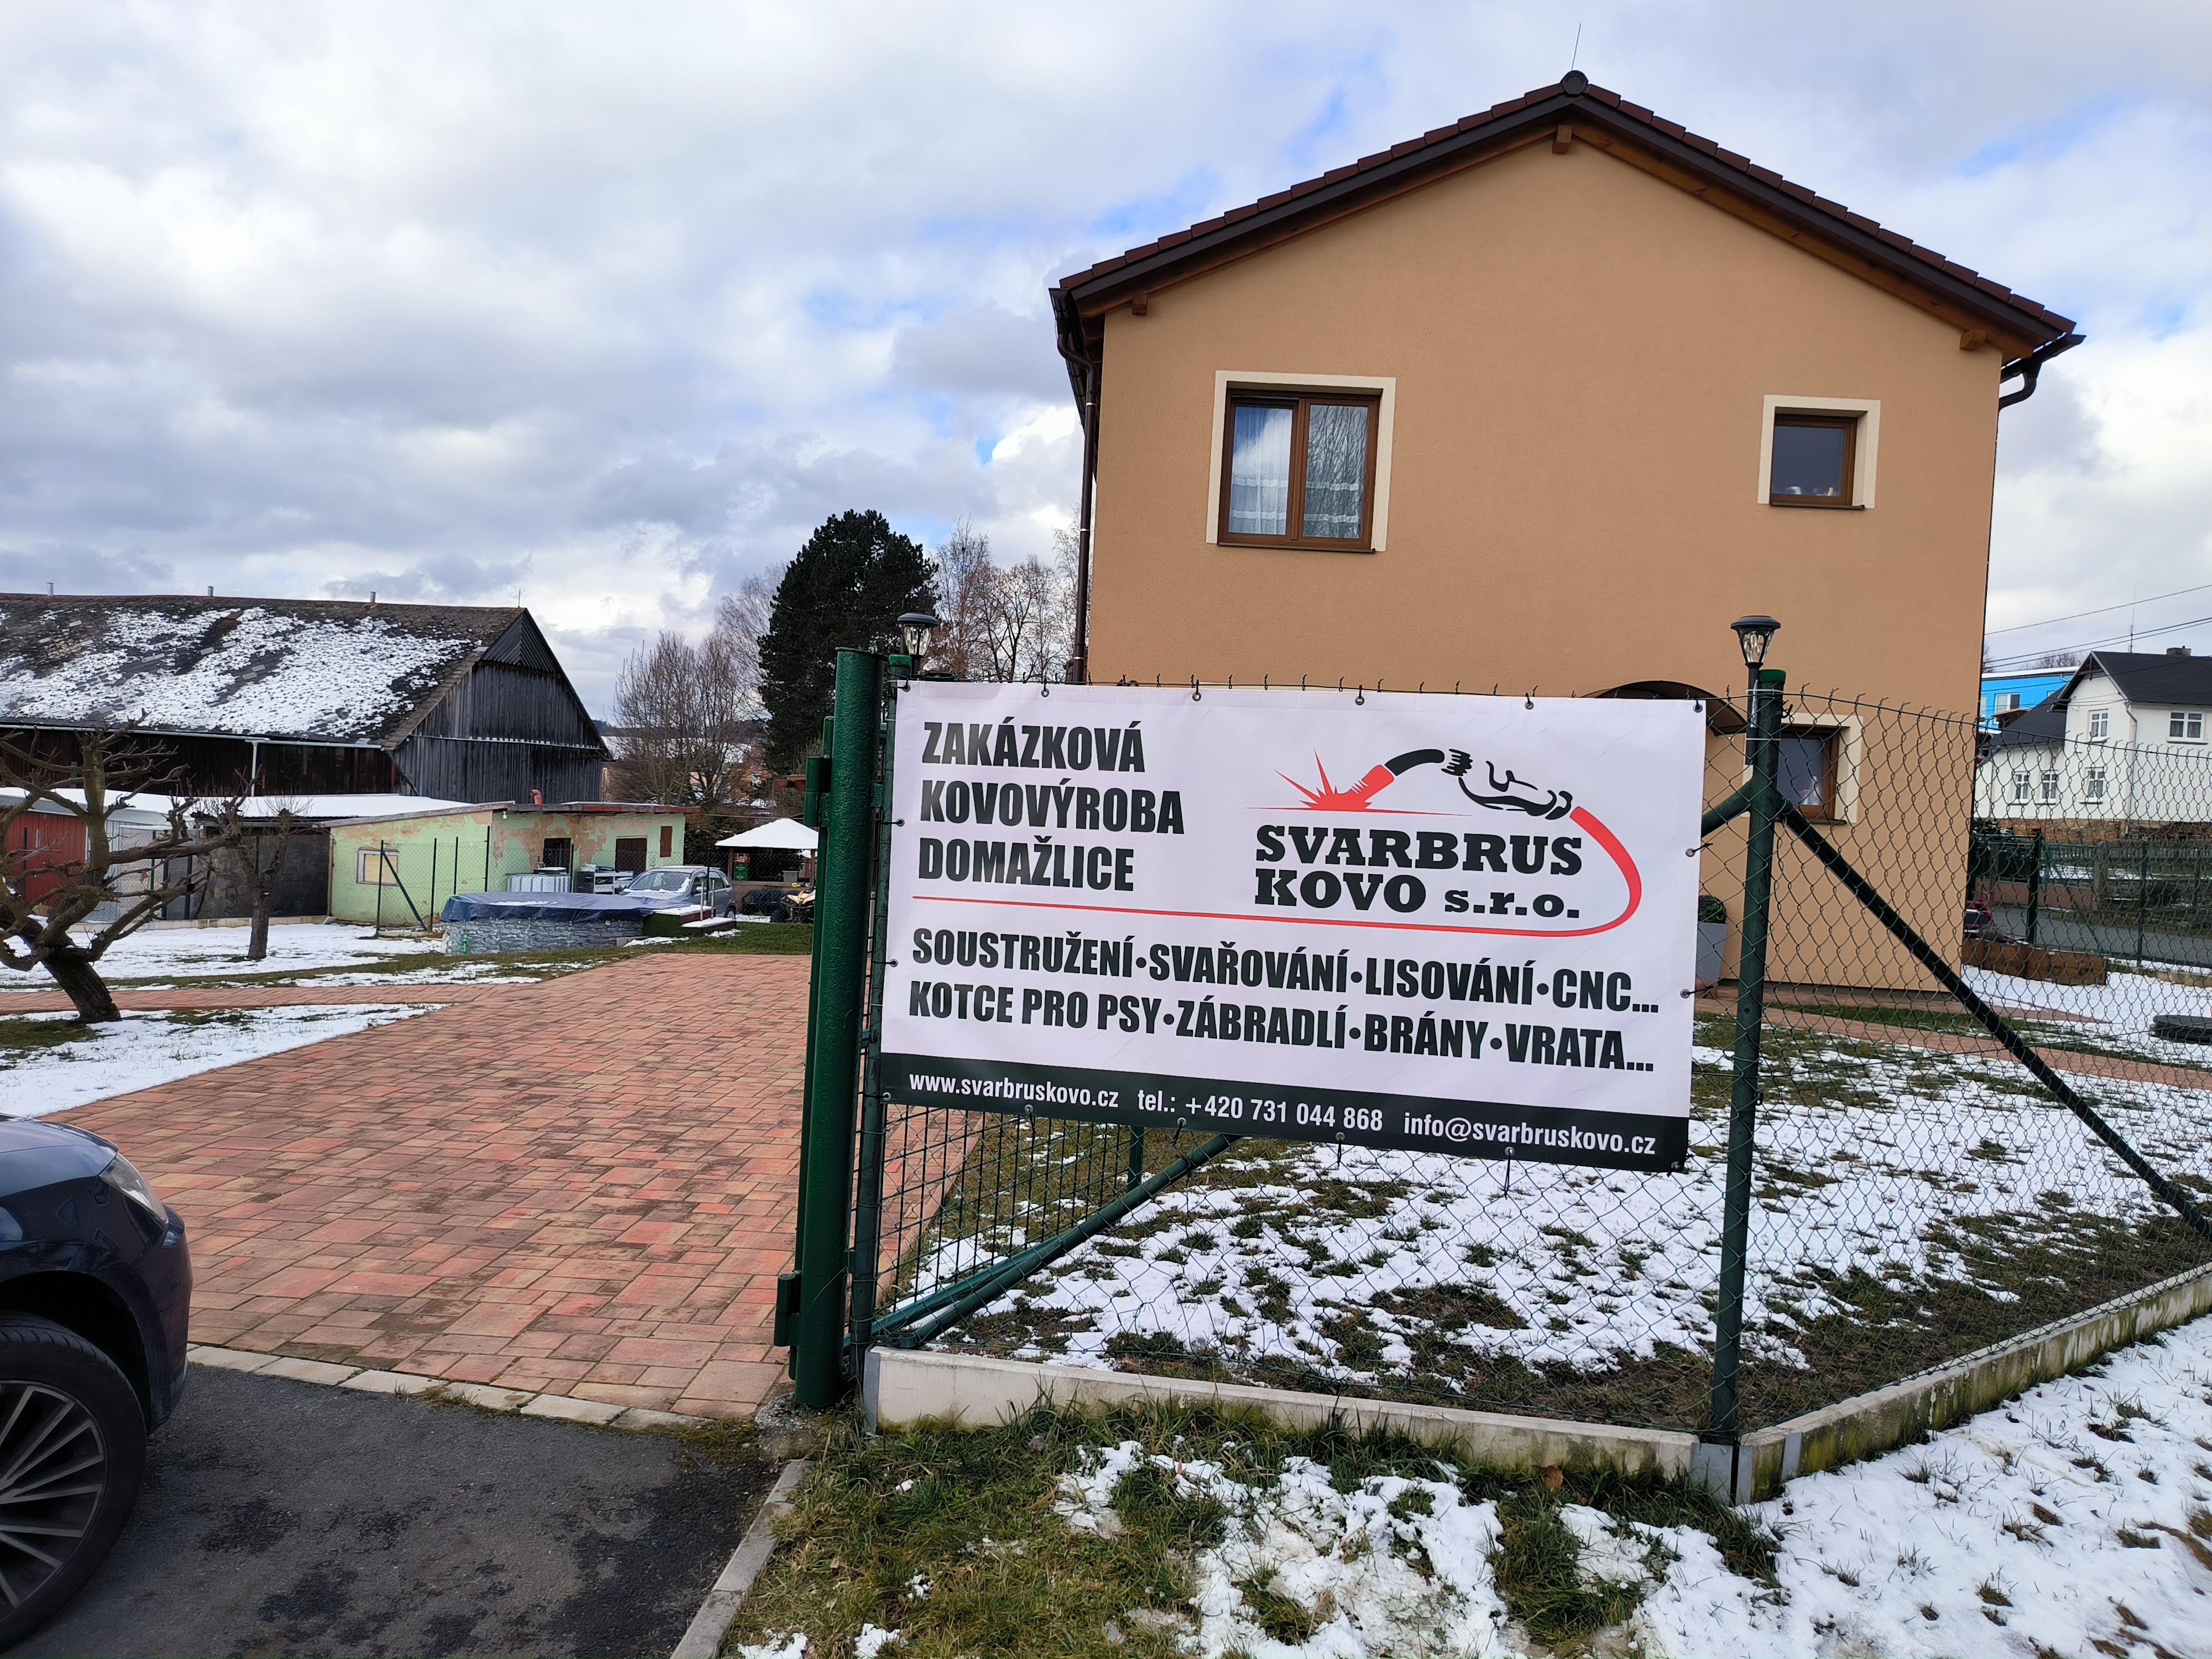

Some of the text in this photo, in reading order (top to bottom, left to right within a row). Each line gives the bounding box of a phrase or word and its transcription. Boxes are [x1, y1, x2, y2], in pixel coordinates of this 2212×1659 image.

[922, 716, 1145, 773] ZAKÁZKOVÁ
[920, 778, 1185, 834] KOVOVÝROBA
[918, 835, 1134, 891] DOMAŽLICE
[1256, 825, 1582, 876] SVARBRUS
[1254, 868, 1579, 919] KOVO s.r.o.
[909, 980, 1014, 1023] KOTCE
[1021, 988, 1088, 1029] PRO
[909, 1074, 1656, 1155] www.svarbruskovo.cz tel.: +420 731 044 868 info@svarbruskovo.cz
